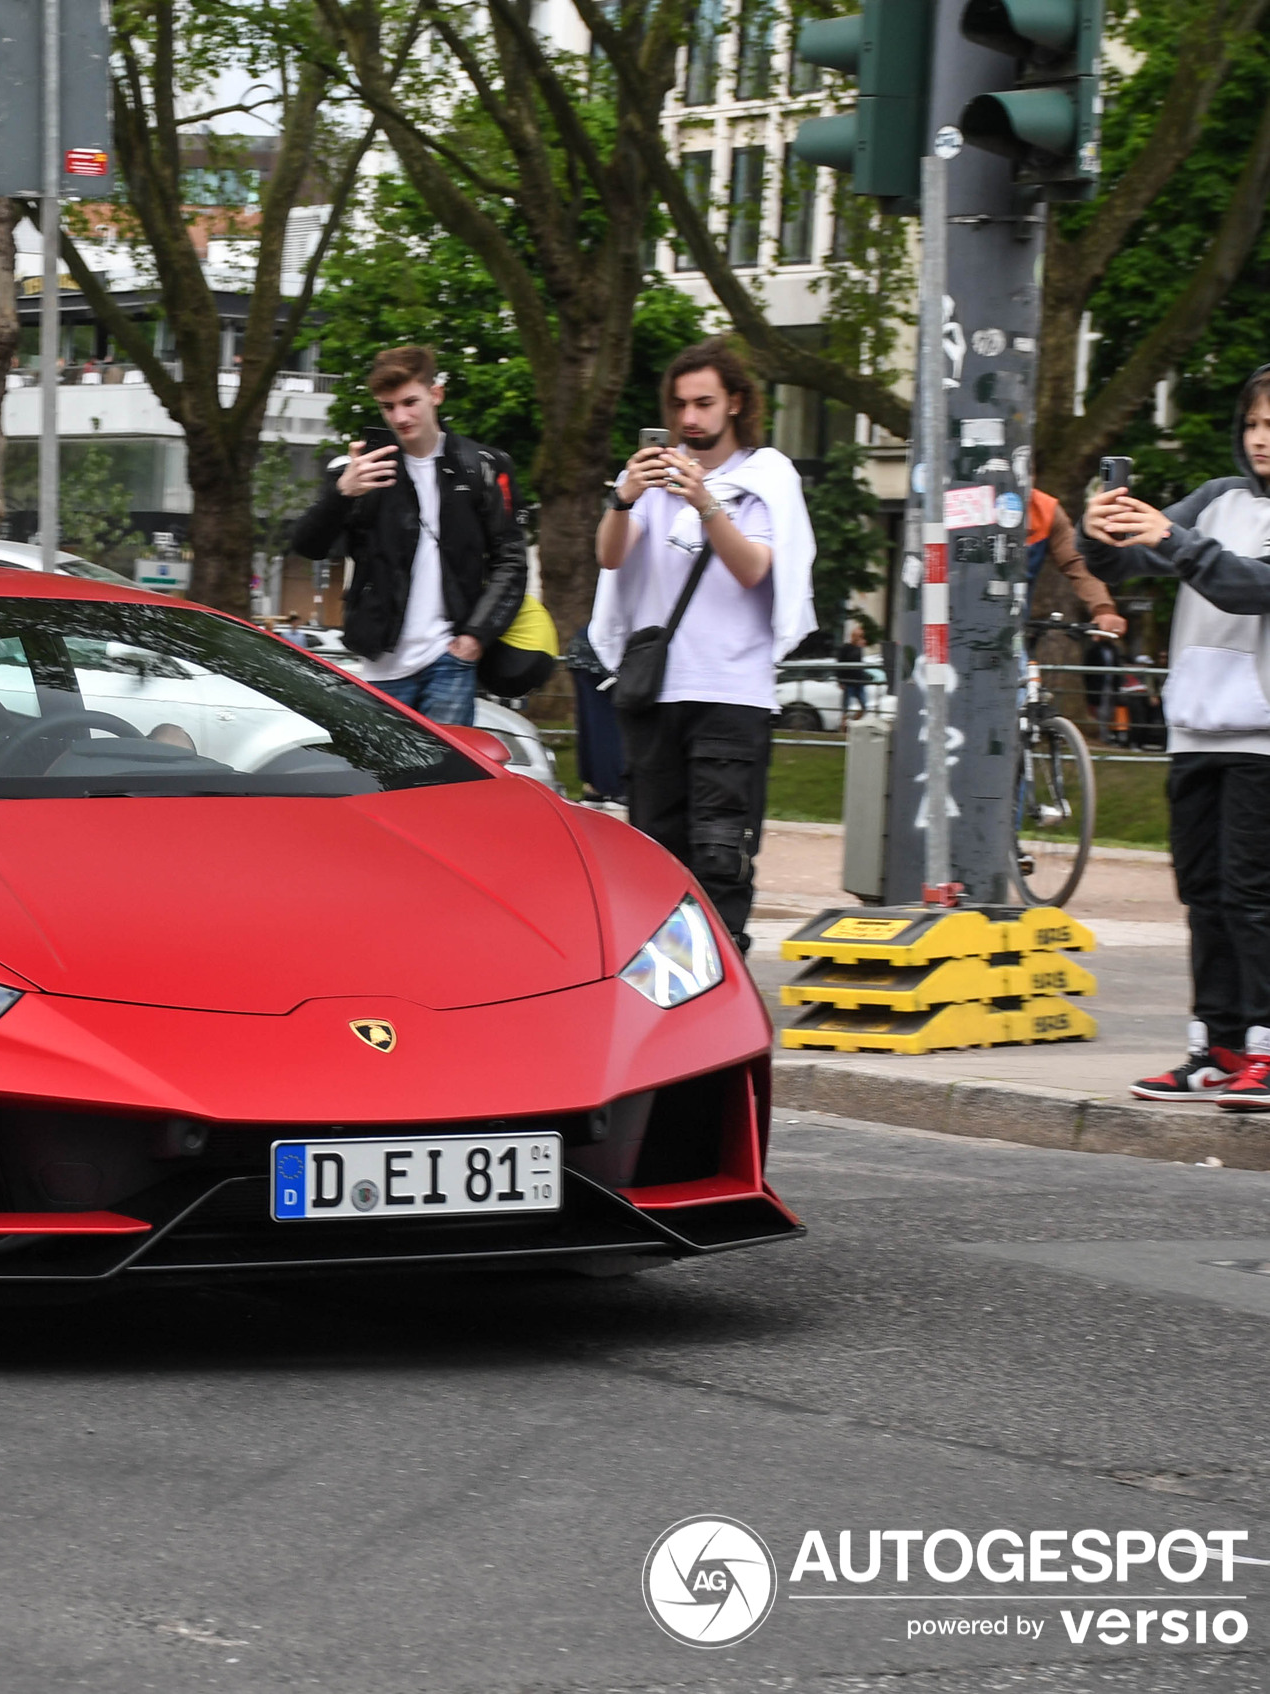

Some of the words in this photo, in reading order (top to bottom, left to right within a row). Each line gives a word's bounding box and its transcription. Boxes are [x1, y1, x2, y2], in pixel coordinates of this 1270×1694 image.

[530, 1144, 551, 1160] 04
[312, 1152, 344, 1208] D
[385, 1149, 447, 1205] EI
[465, 1146, 525, 1202] 81
[284, 1189, 298, 1206] D
[532, 1183, 552, 1200] 10
